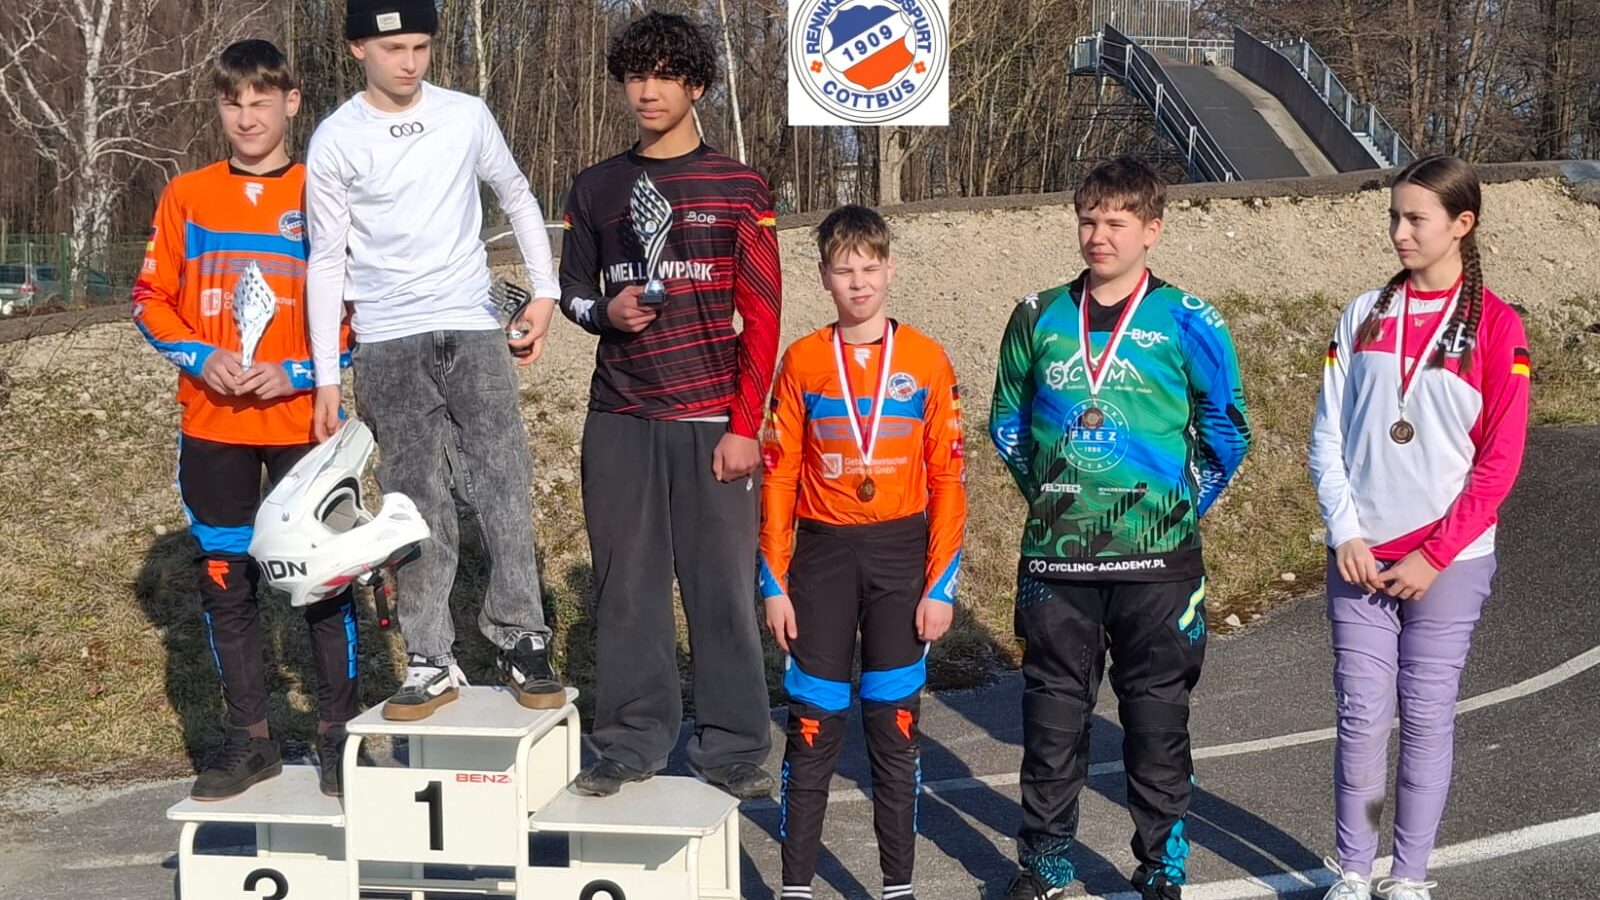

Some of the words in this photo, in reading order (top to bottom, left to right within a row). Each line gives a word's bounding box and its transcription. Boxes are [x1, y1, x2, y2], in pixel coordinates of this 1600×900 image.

[610, 261, 714, 283] MELLWPARK
[1130, 328, 1162, 342] BMX
[1072, 430, 1116, 441] FREZ
[1048, 559, 1167, 572] CYCLING-ACADEMY.PL
[456, 773, 509, 784] BENZ
[414, 781, 444, 851] 1
